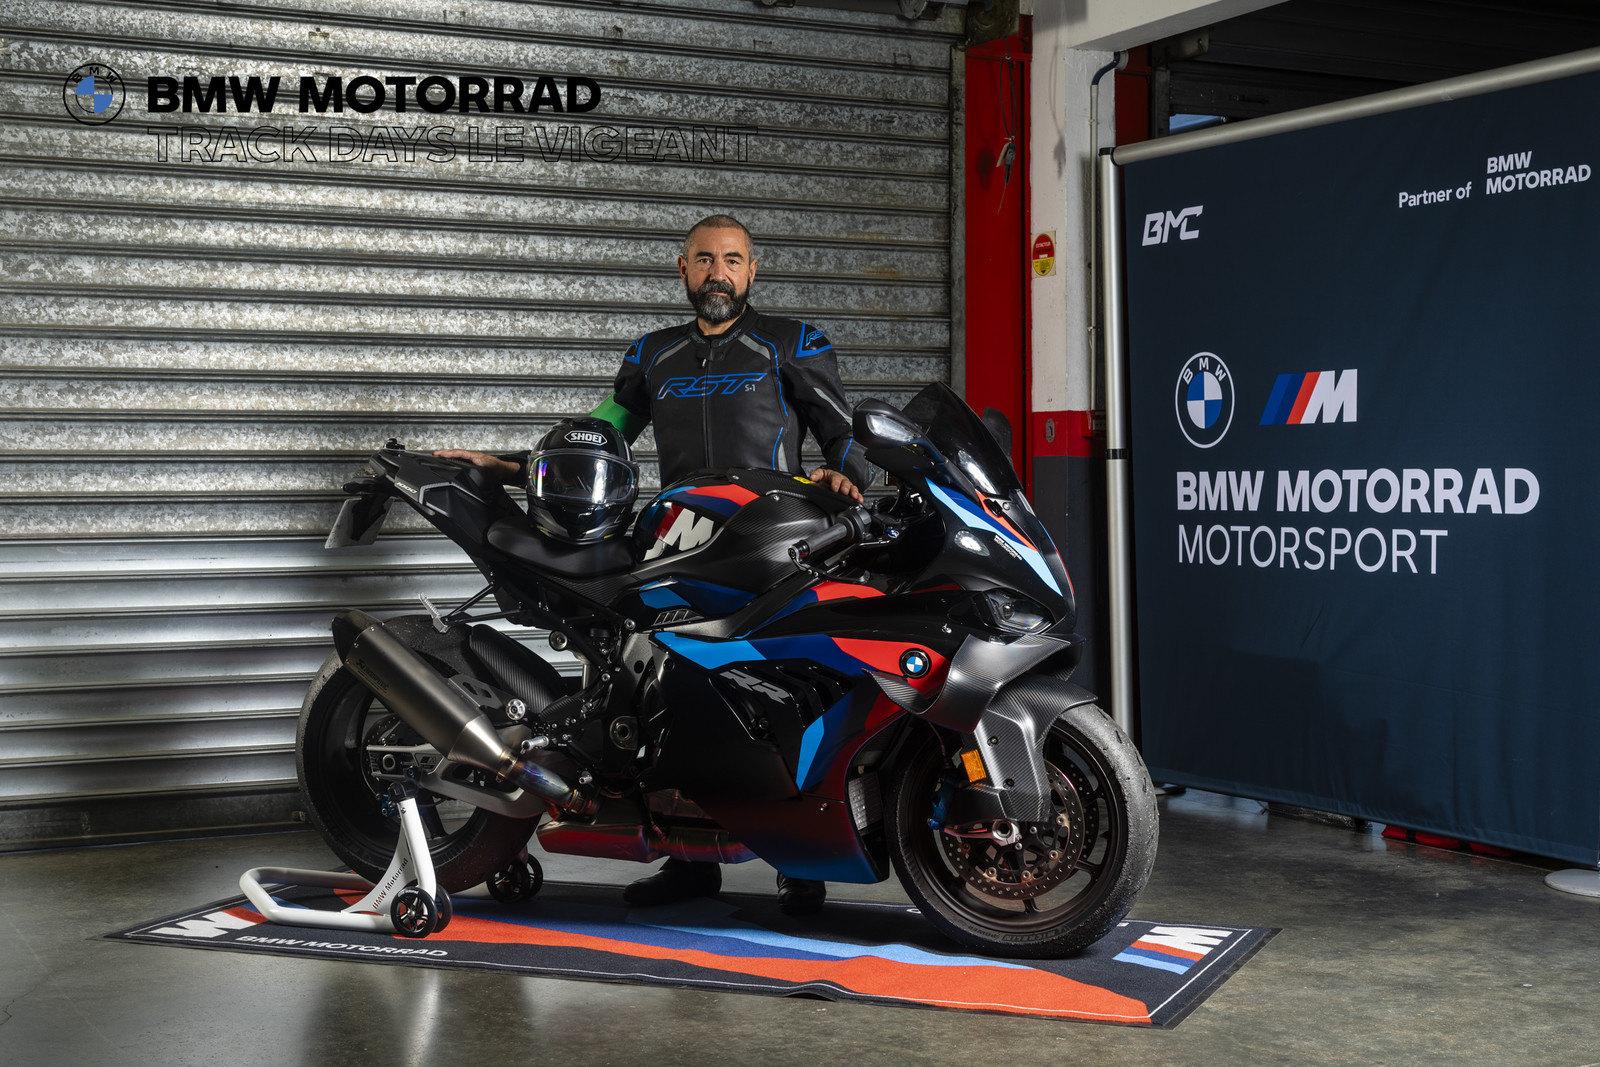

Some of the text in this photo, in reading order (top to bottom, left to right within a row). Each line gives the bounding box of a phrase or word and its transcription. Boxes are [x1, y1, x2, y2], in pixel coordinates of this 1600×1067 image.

[1487, 151, 1532, 174] BMW
[1486, 164, 1591, 195] MOTORRAD
[1399, 181, 1472, 208] Partner of
[1142, 205, 1203, 246] BMC
[1183, 357, 1227, 384] BMW
[657, 373, 767, 399] RST
[570, 432, 602, 443] SHOEI
[1176, 468, 1540, 514] BMW MOTORRAD
[1178, 524, 1448, 574] MOTORSPORT
[236, 935, 448, 957] BMW MOTORRAD
